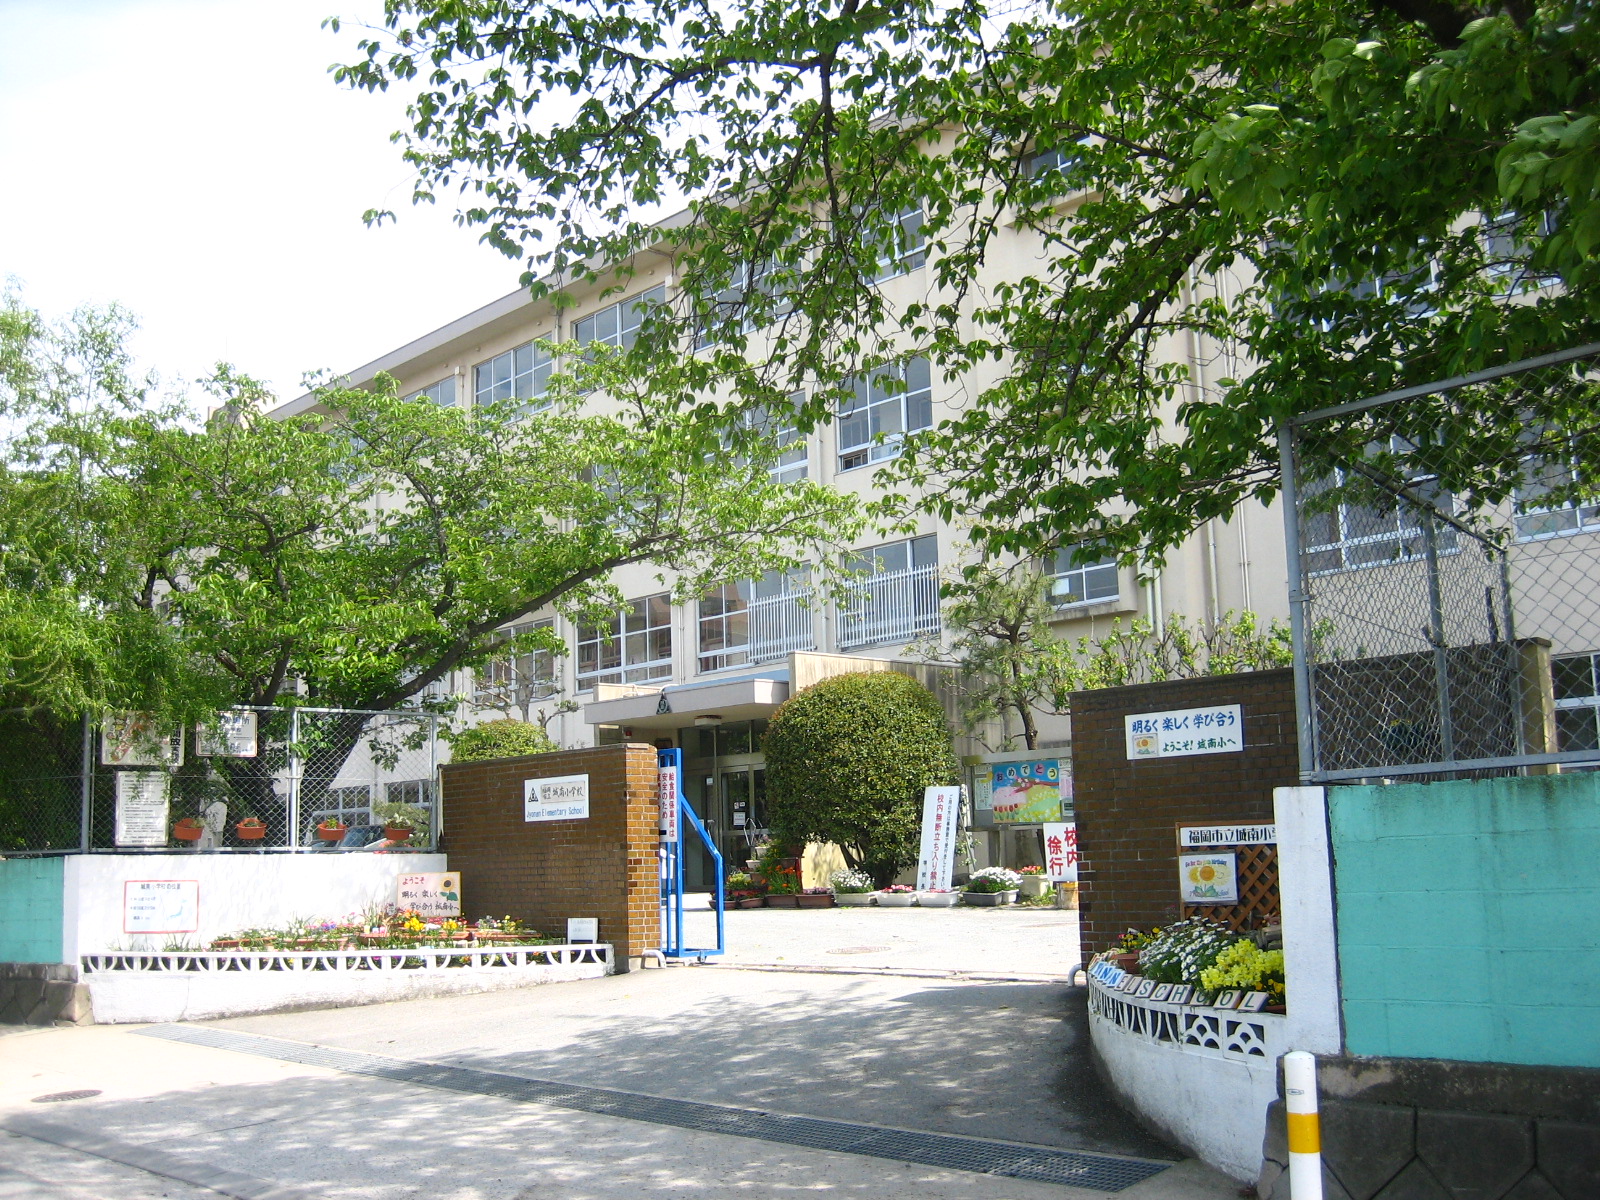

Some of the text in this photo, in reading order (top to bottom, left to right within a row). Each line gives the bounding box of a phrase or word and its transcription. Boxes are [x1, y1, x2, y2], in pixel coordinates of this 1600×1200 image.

[1132, 711, 1235, 733] 明るく 楽しく 学び合う
[1197, 737, 1236, 750] 城南小へ
[996, 764, 1056, 782] おめでとう
[552, 786, 584, 798] 城南小学校
[542, 808, 567, 817] Elementary
[568, 806, 585, 815] School
[929, 794, 944, 889] 校内無断立ち入り禁止
[1064, 827, 1077, 867] 校内
[1047, 835, 1063, 876] 徐行
[402, 877, 425, 885] ようこそ
